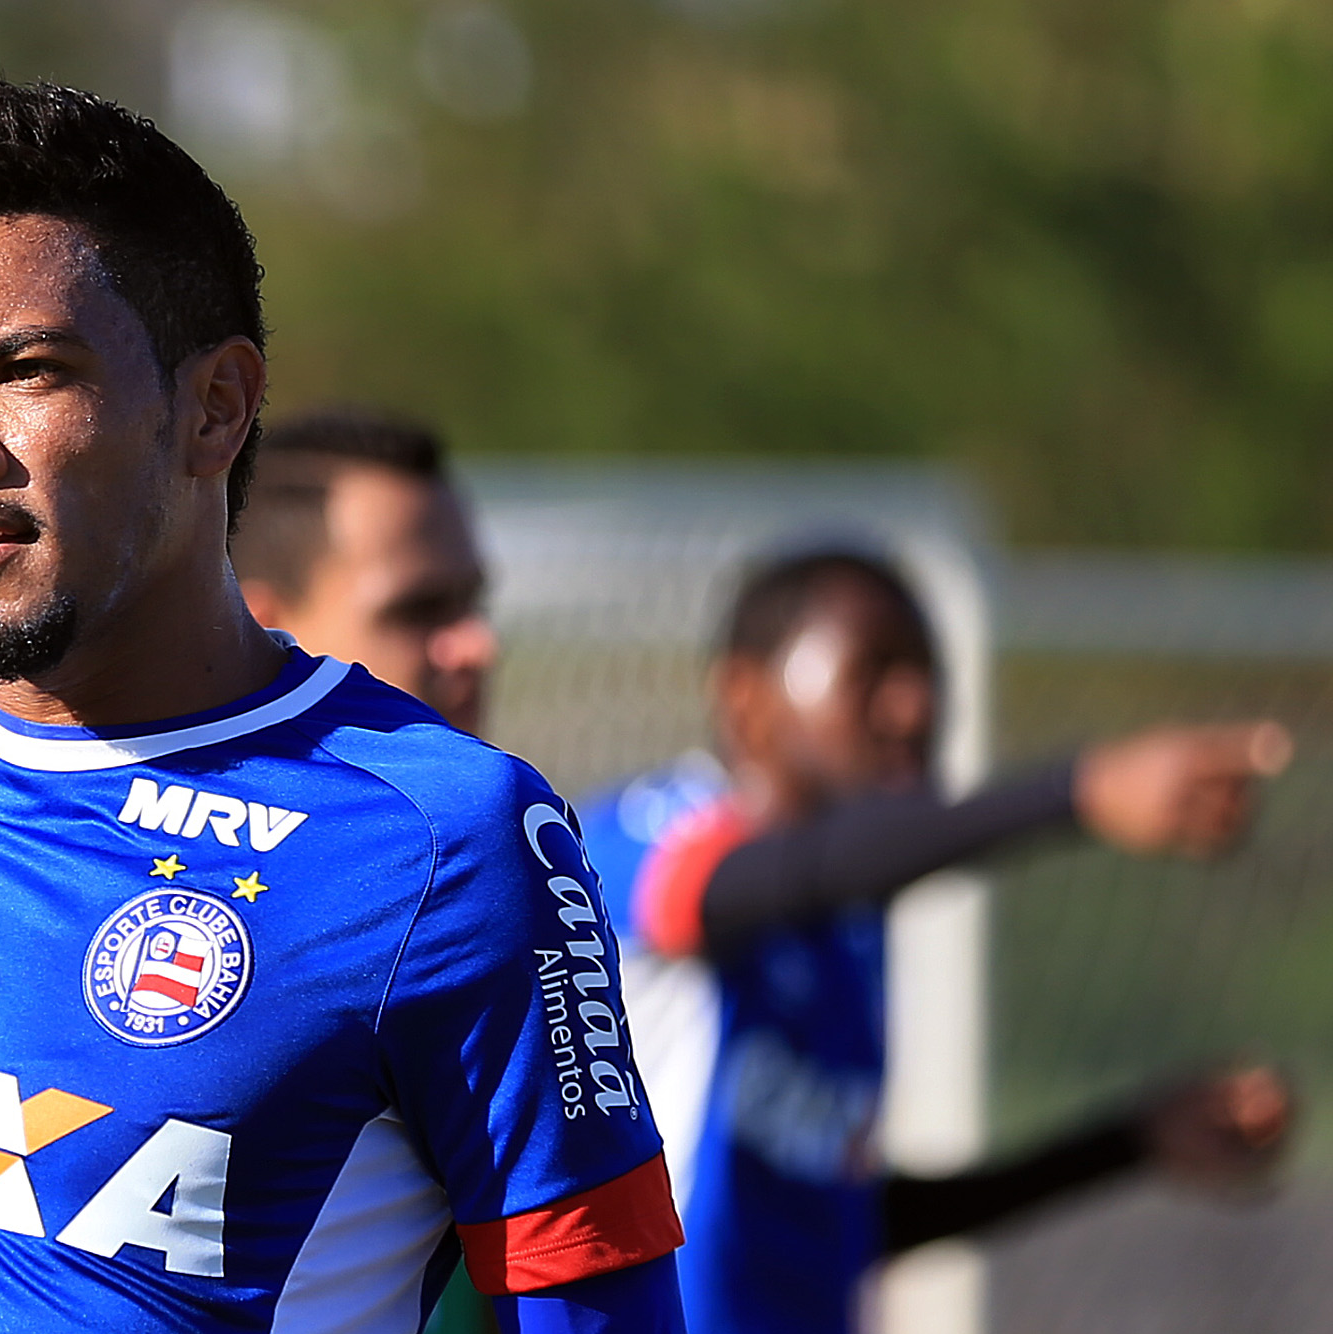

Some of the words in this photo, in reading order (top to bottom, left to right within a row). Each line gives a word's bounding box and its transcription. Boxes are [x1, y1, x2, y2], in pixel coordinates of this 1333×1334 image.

[117, 777, 310, 852] MRV
[94, 898, 164, 998] ESPORTE
[169, 896, 238, 948] CLUBE
[192, 951, 242, 1019] BAHIA
[124, 1011, 165, 1034] 1931
[533, 949, 586, 1121] Alimentos
